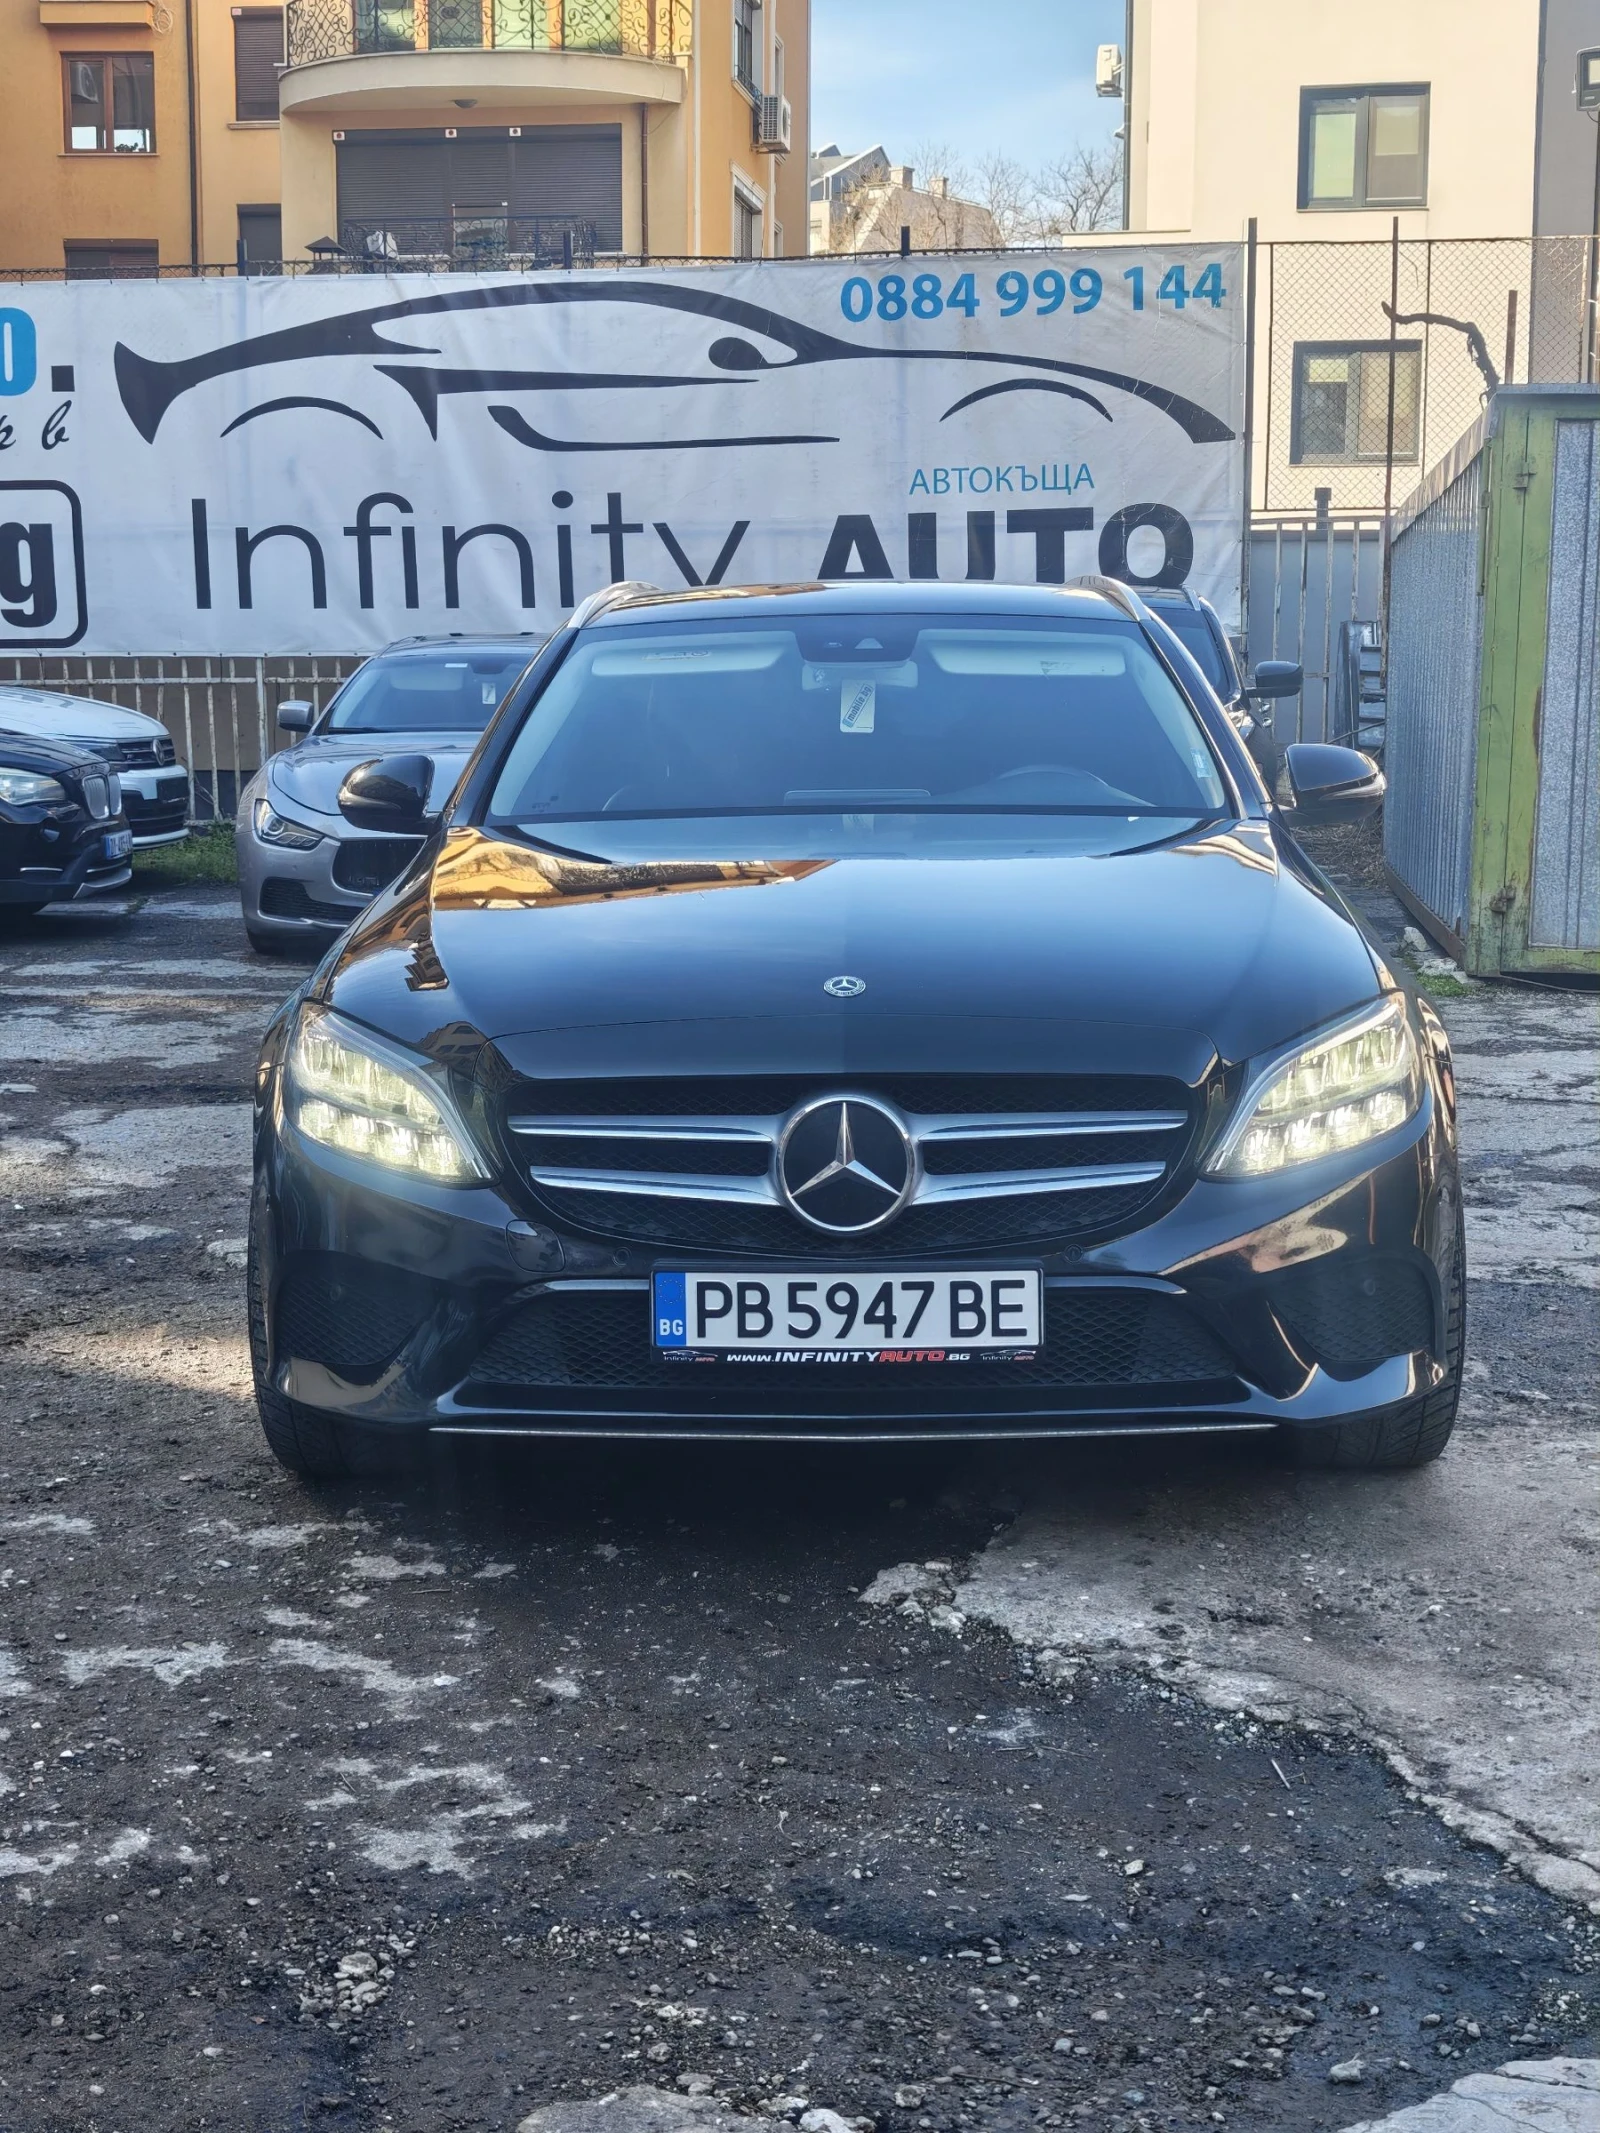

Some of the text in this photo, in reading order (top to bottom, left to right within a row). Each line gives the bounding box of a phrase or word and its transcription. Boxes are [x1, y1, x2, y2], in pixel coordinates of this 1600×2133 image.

[840, 263, 1227, 322] 0884 999 144
[909, 463, 1095, 496] АВТОКЪЩА
[191, 490, 1194, 609] Infinity AUTO
[659, 1318, 684, 1336] BG
[697, 1279, 1028, 1338] PB 5947 BE
